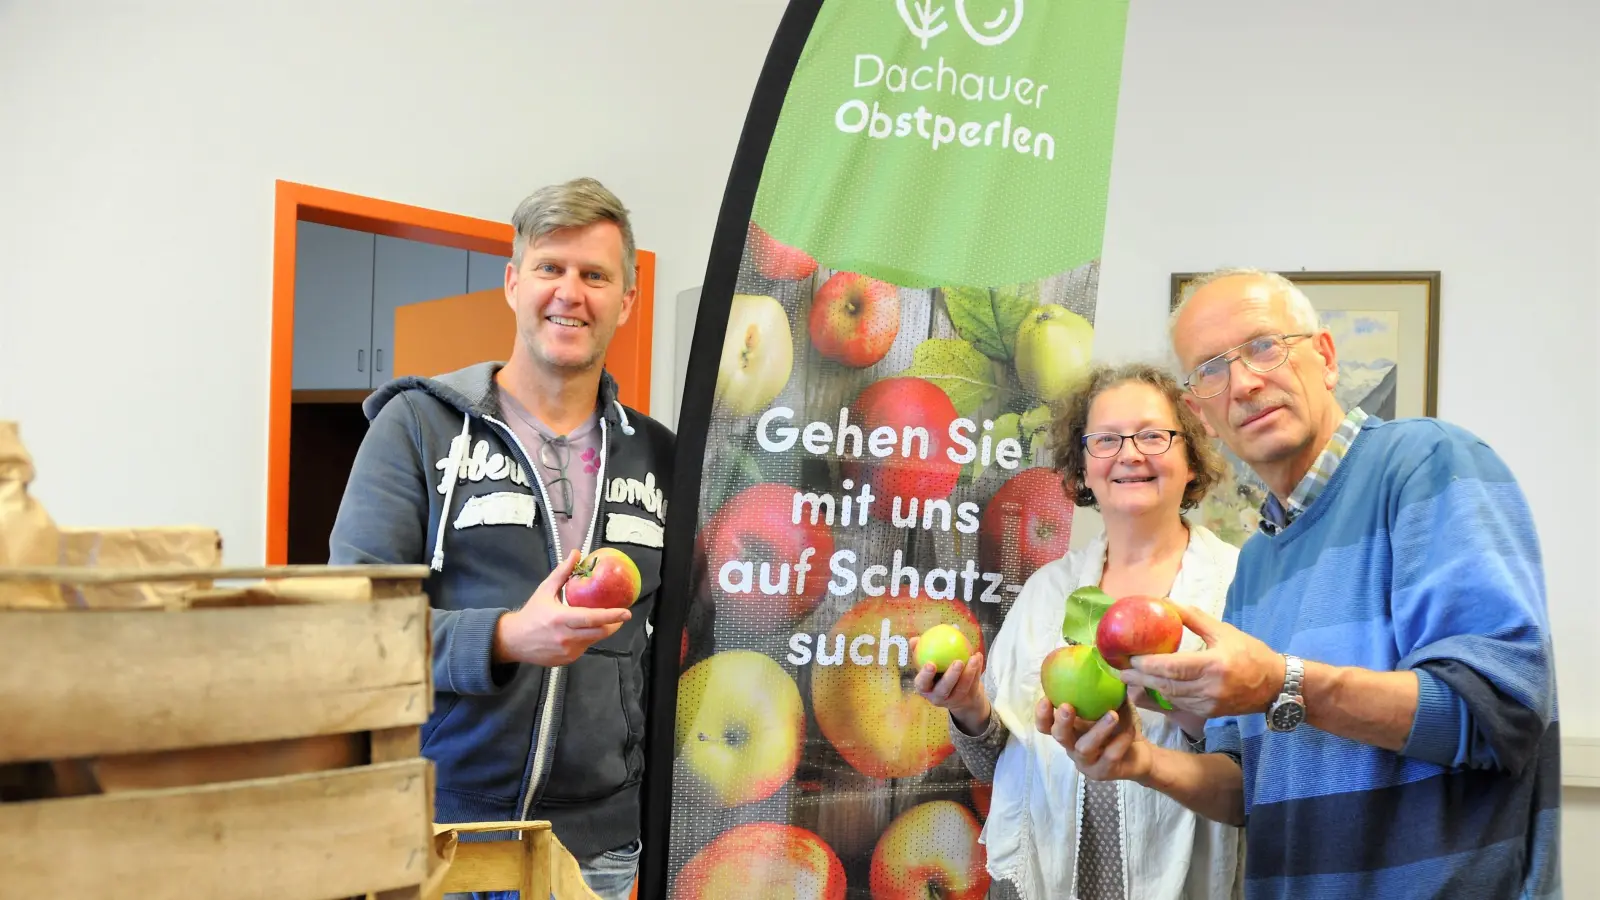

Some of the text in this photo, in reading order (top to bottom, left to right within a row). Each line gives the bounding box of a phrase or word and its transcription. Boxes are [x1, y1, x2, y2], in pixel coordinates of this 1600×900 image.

[853, 53, 1048, 109] Dachauer
[834, 99, 1055, 160] Obstperlen
[756, 406, 1023, 470] Gehen Sie
[791, 478, 980, 534] mit uns
[718, 546, 1023, 603] auf Schatz-
[787, 618, 960, 667] such
